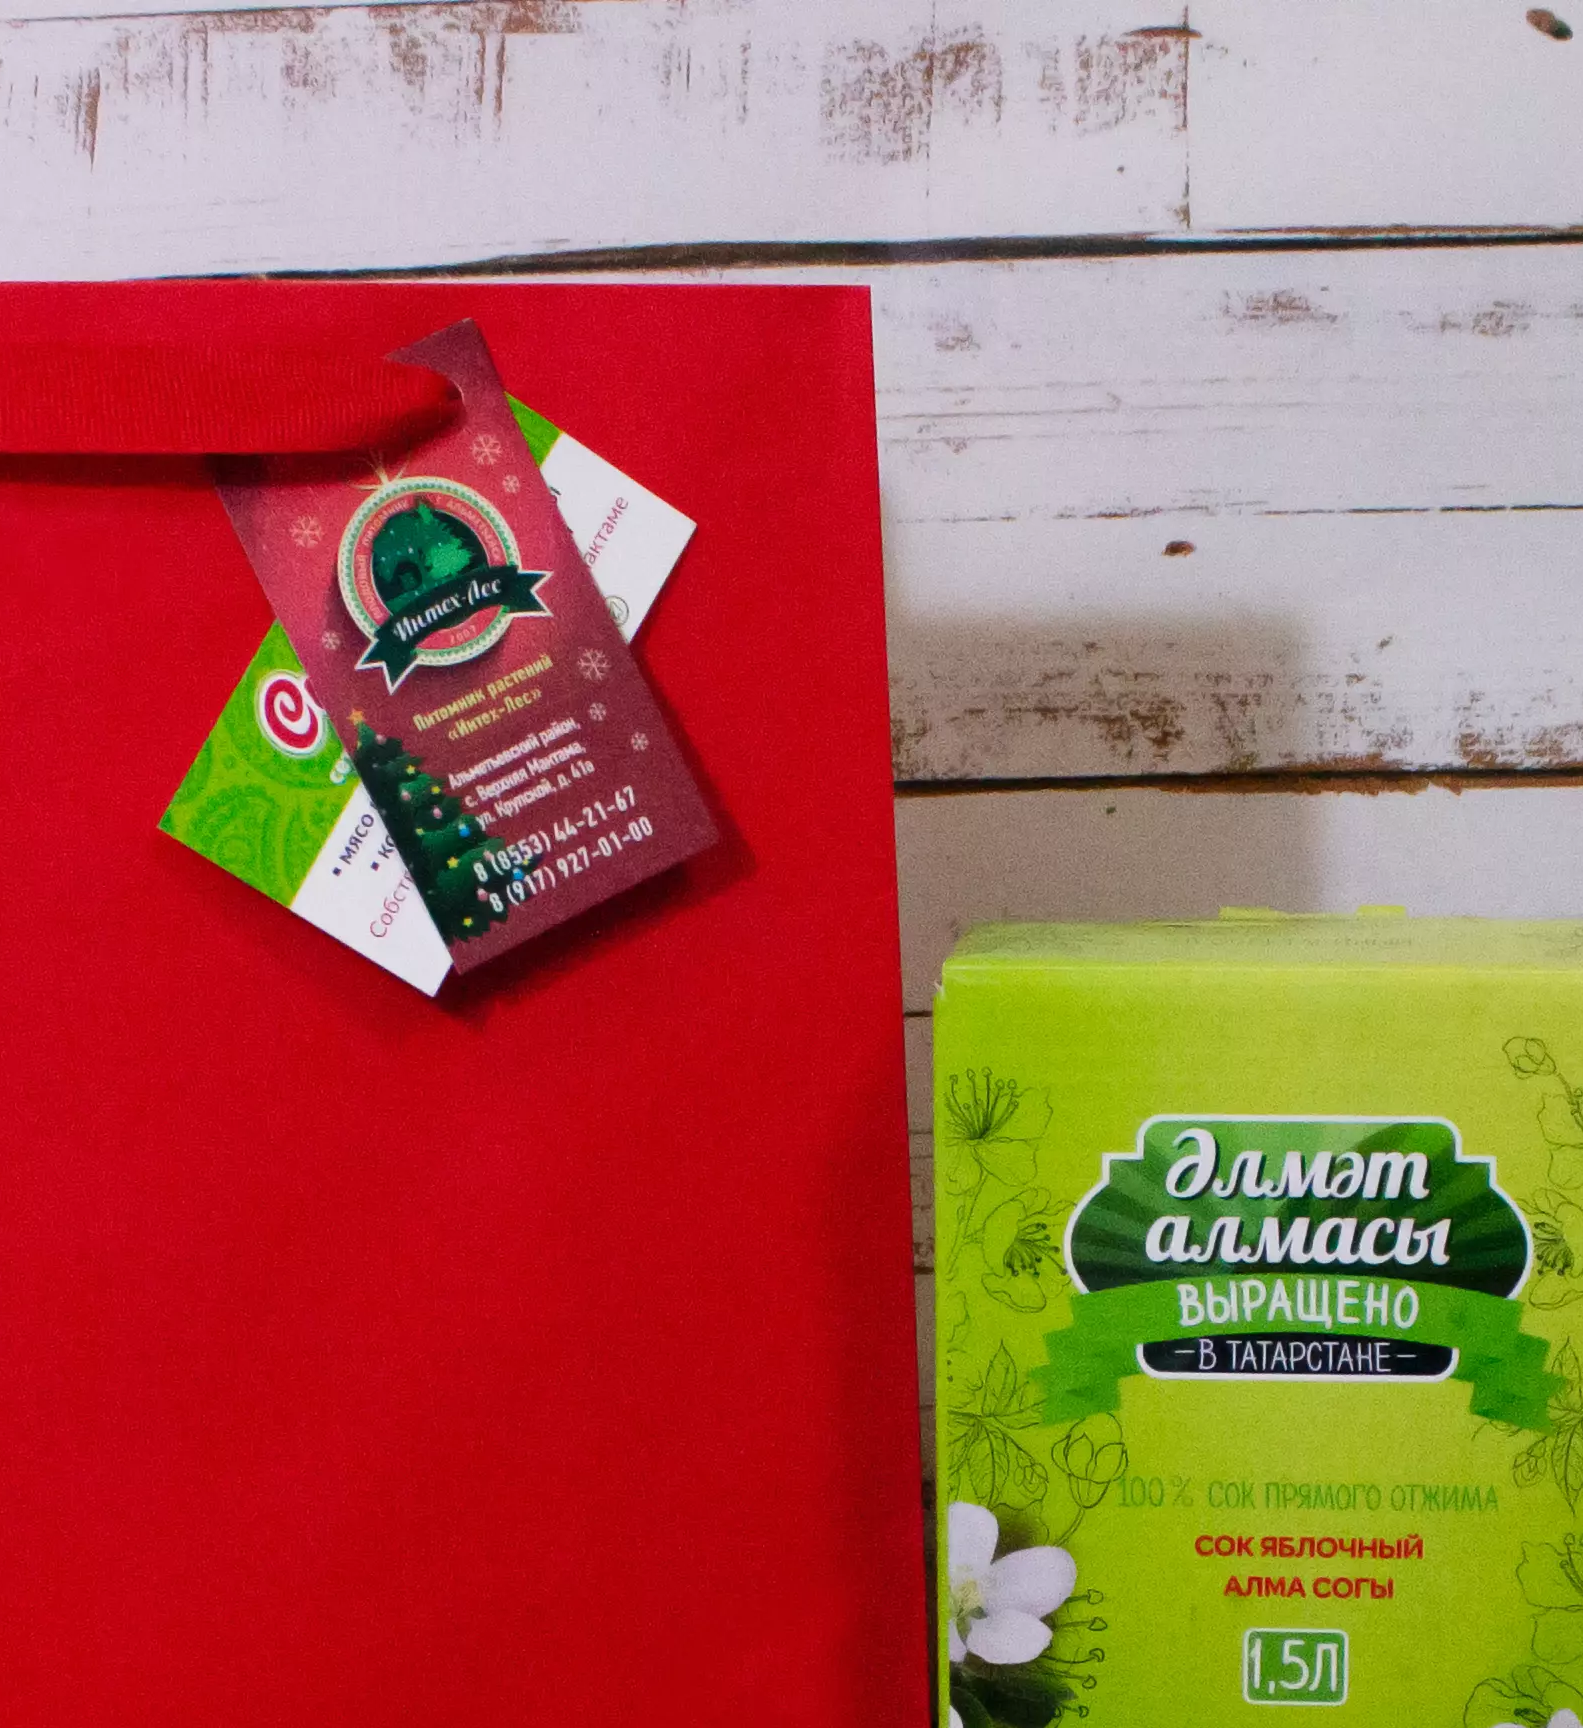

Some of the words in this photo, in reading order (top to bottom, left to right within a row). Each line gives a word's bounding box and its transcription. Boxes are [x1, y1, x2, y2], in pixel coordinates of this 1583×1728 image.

[413, 688, 486, 731] Питомник
[486, 654, 553, 696] растений
[448, 688, 542, 741] «Интех-Лес»
[448, 733, 540, 790] Альметьевский
[538, 717, 581, 748] район,
[475, 769, 529, 802] Верхняя
[494, 778, 557, 818] Крупской,
[338, 813, 375, 866] мясо
[472, 861, 489, 883] 8
[490, 830, 551, 876] (8553)
[553, 785, 636, 842] 44-21-67
[488, 892, 504, 914] 8
[506, 866, 557, 906] (917)
[556, 816, 654, 879] 927-01-00
[1164, 1127, 1431, 1200] Әлмәт
[1143, 1213, 1451, 1267] алмасы
[1177, 1279, 1420, 1331] ВЫРАЩЕНО
[1225, 1338, 1393, 1374] ТАТАРСТАНЕ
[1208, 1480, 1254, 1509] СОК
[1265, 1482, 1382, 1512] ПРЯМОГО
[1390, 1483, 1499, 1513] ОТЖИМА
[1195, 1534, 1254, 1558] СОК
[1260, 1533, 1424, 1560] ЯБЛОЧНЫЙ
[1223, 1575, 1306, 1599] АЛМА
[1313, 1576, 1394, 1600] СОГЫ
[1250, 1638, 1339, 1694] 1,5Л
